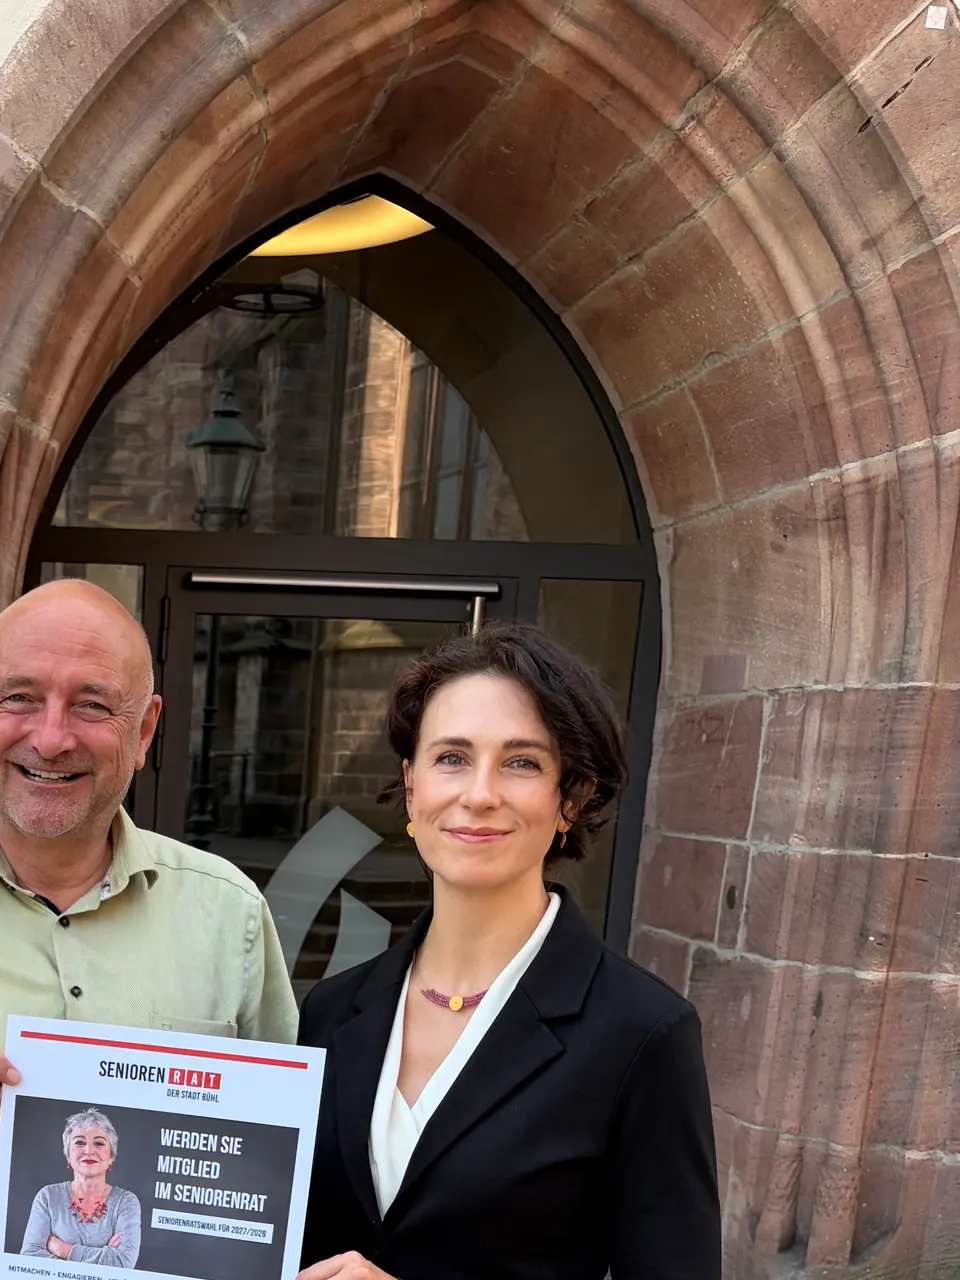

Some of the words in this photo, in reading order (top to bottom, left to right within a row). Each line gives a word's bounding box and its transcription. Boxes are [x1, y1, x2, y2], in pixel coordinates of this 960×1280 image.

[99, 1060, 164, 1083] SENIOREN
[172, 1069, 216, 1088] RAT
[167, 1088, 179, 1097] DER
[181, 1090, 200, 1100] STADT
[201, 1092, 218, 1102] BÜHL
[159, 1129, 217, 1152] WERDEN
[219, 1136, 242, 1154] SIE
[157, 1155, 220, 1179] MITGLIED
[155, 1182, 170, 1199] IM
[173, 1184, 266, 1212] SENIORENRAT
[157, 1216, 216, 1231] SENIORENRATSWAHL
[218, 1224, 230, 1232] FÜR
[8, 1265, 50, 1276] MITMACHEN
